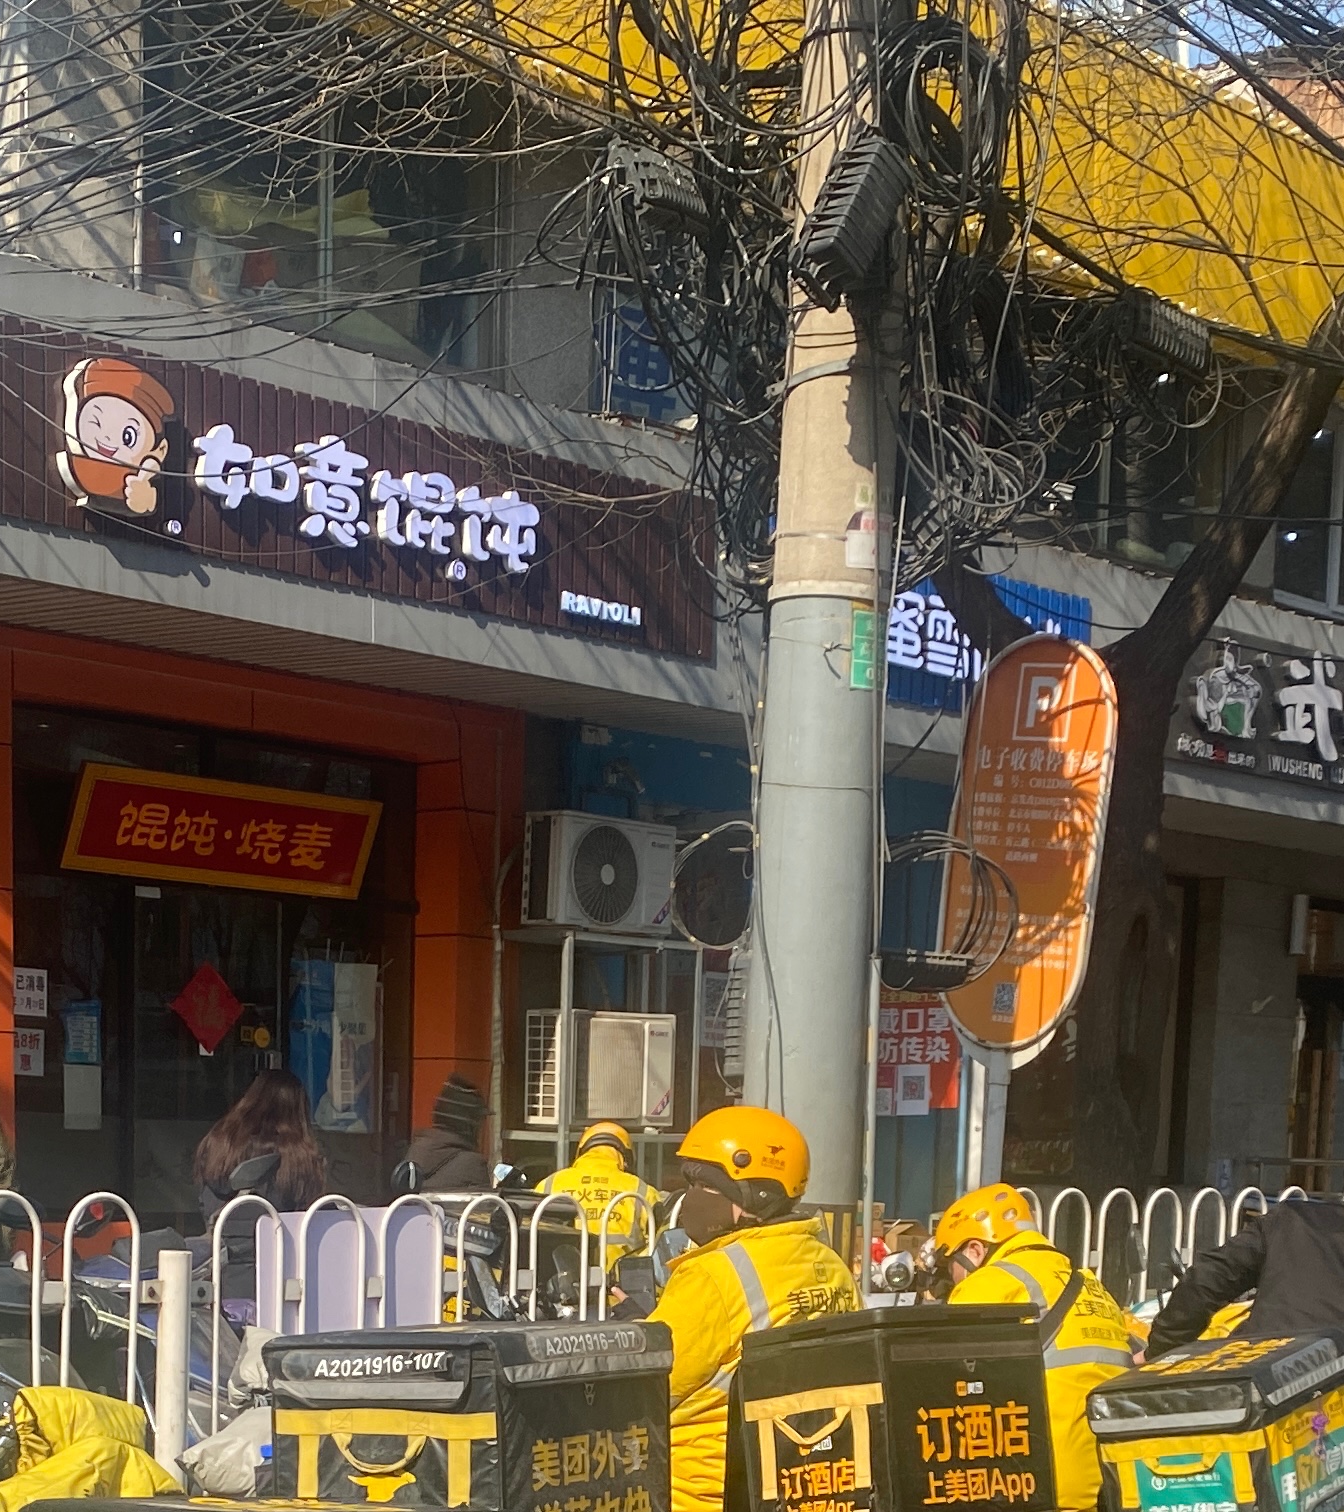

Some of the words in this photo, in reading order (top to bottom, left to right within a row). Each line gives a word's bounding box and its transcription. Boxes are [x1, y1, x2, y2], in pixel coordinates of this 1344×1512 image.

[193, 423, 540, 574] 如意馄饨
[1268, 753, 1324, 782] WUSHENG
[115, 800, 334, 871] 馄饨·烧麦
[314, 1350, 447, 1379] A2021916-107
[545, 1330, 640, 1358] A2021916-107
[916, 1400, 1030, 1463] 订酒店
[532, 1424, 651, 1493] 美团外卖
[780, 1457, 855, 1501] 订酒店
[923, 1467, 1036, 1504] 上美团App
